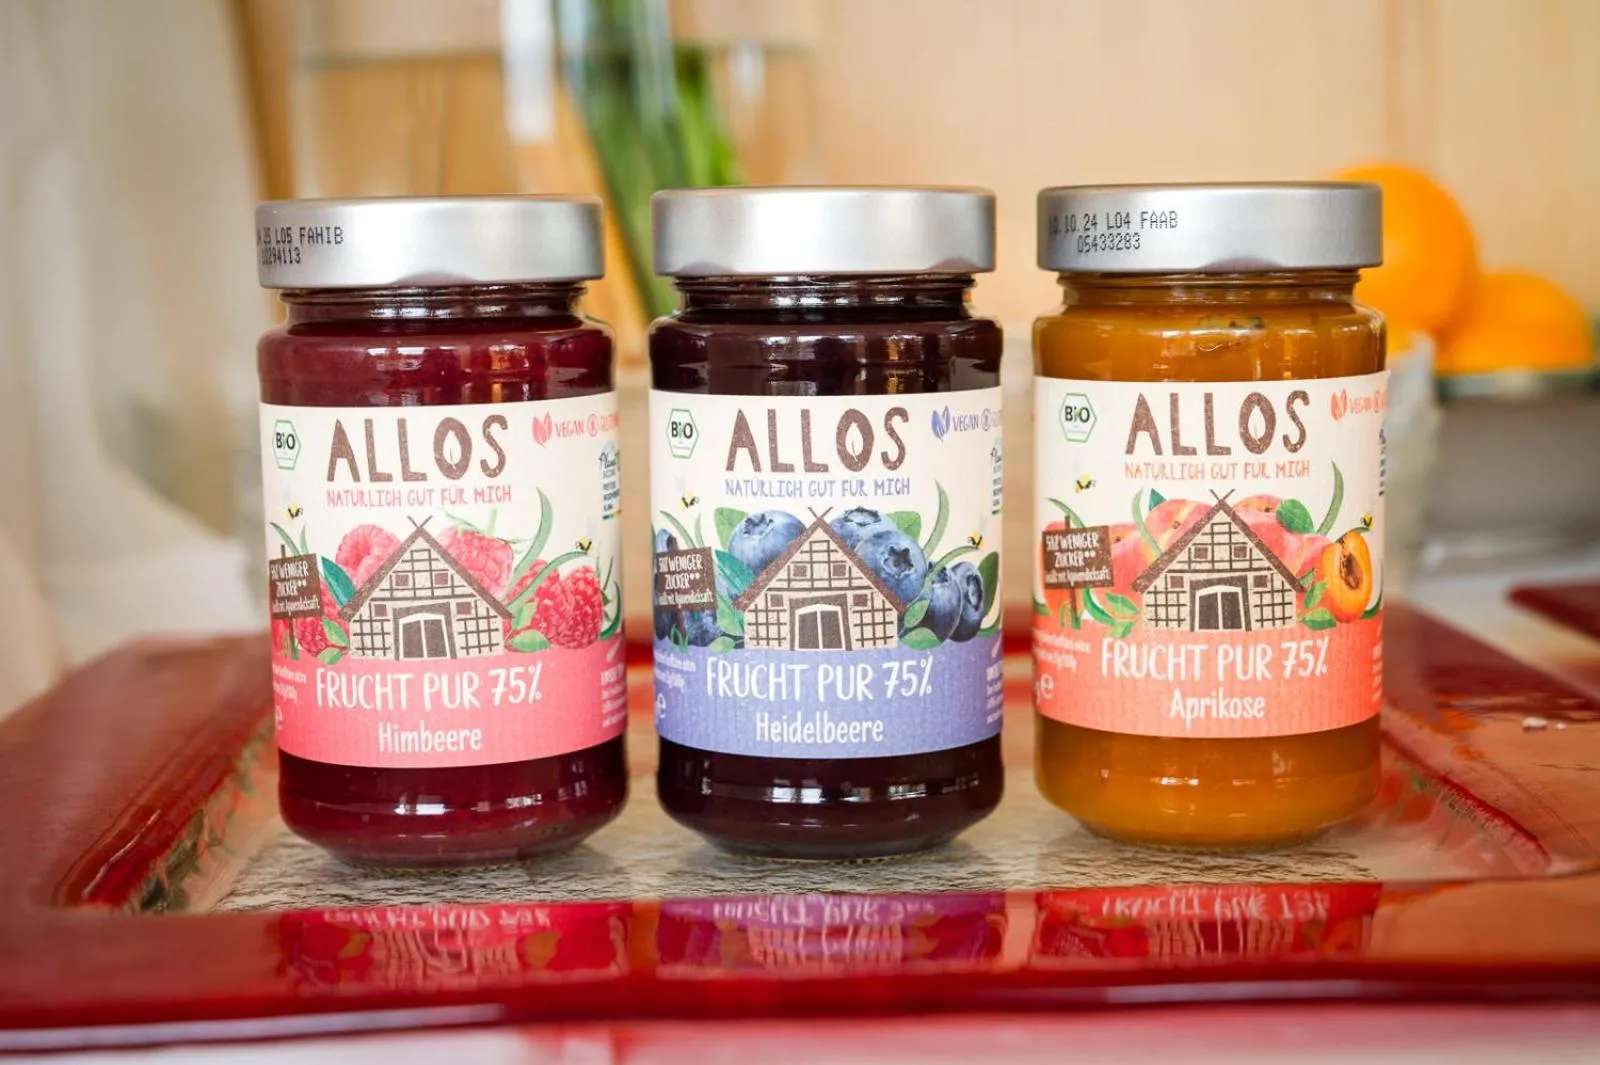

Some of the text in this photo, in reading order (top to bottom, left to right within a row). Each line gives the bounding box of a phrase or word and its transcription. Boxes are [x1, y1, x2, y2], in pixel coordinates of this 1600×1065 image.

[300, 226, 343, 244] FAHIB
[1106, 212, 1131, 230] L04
[1140, 211, 1178, 229] FAAB
[1077, 232, 1141, 253] 05433283
[555, 420, 584, 438] VEGAN
[952, 413, 979, 432] VEGAN
[1125, 390, 1310, 456] ALLOS
[327, 414, 508, 483] ALLOS
[726, 407, 909, 473] ALLOS
[1210, 463, 1238, 480] GUT
[1275, 459, 1310, 479] MICH
[406, 488, 435, 507] GUT
[473, 484, 512, 504] MICH
[808, 479, 835, 498] GUT
[874, 476, 910, 496] MICH
[1102, 638, 1208, 682] FRUCHT
[1217, 643, 1273, 682] PUR
[1280, 636, 1330, 678] 75%
[316, 667, 414, 711] FRUCHT
[423, 668, 481, 711] PUR
[488, 660, 542, 707] 75%
[706, 657, 809, 701] FRUCHT
[817, 663, 874, 702] PUR
[882, 655, 933, 699] 75%
[1170, 687, 1265, 730] Aprikose
[378, 719, 482, 754] Himbeere
[756, 711, 884, 744] Heidelbeere
